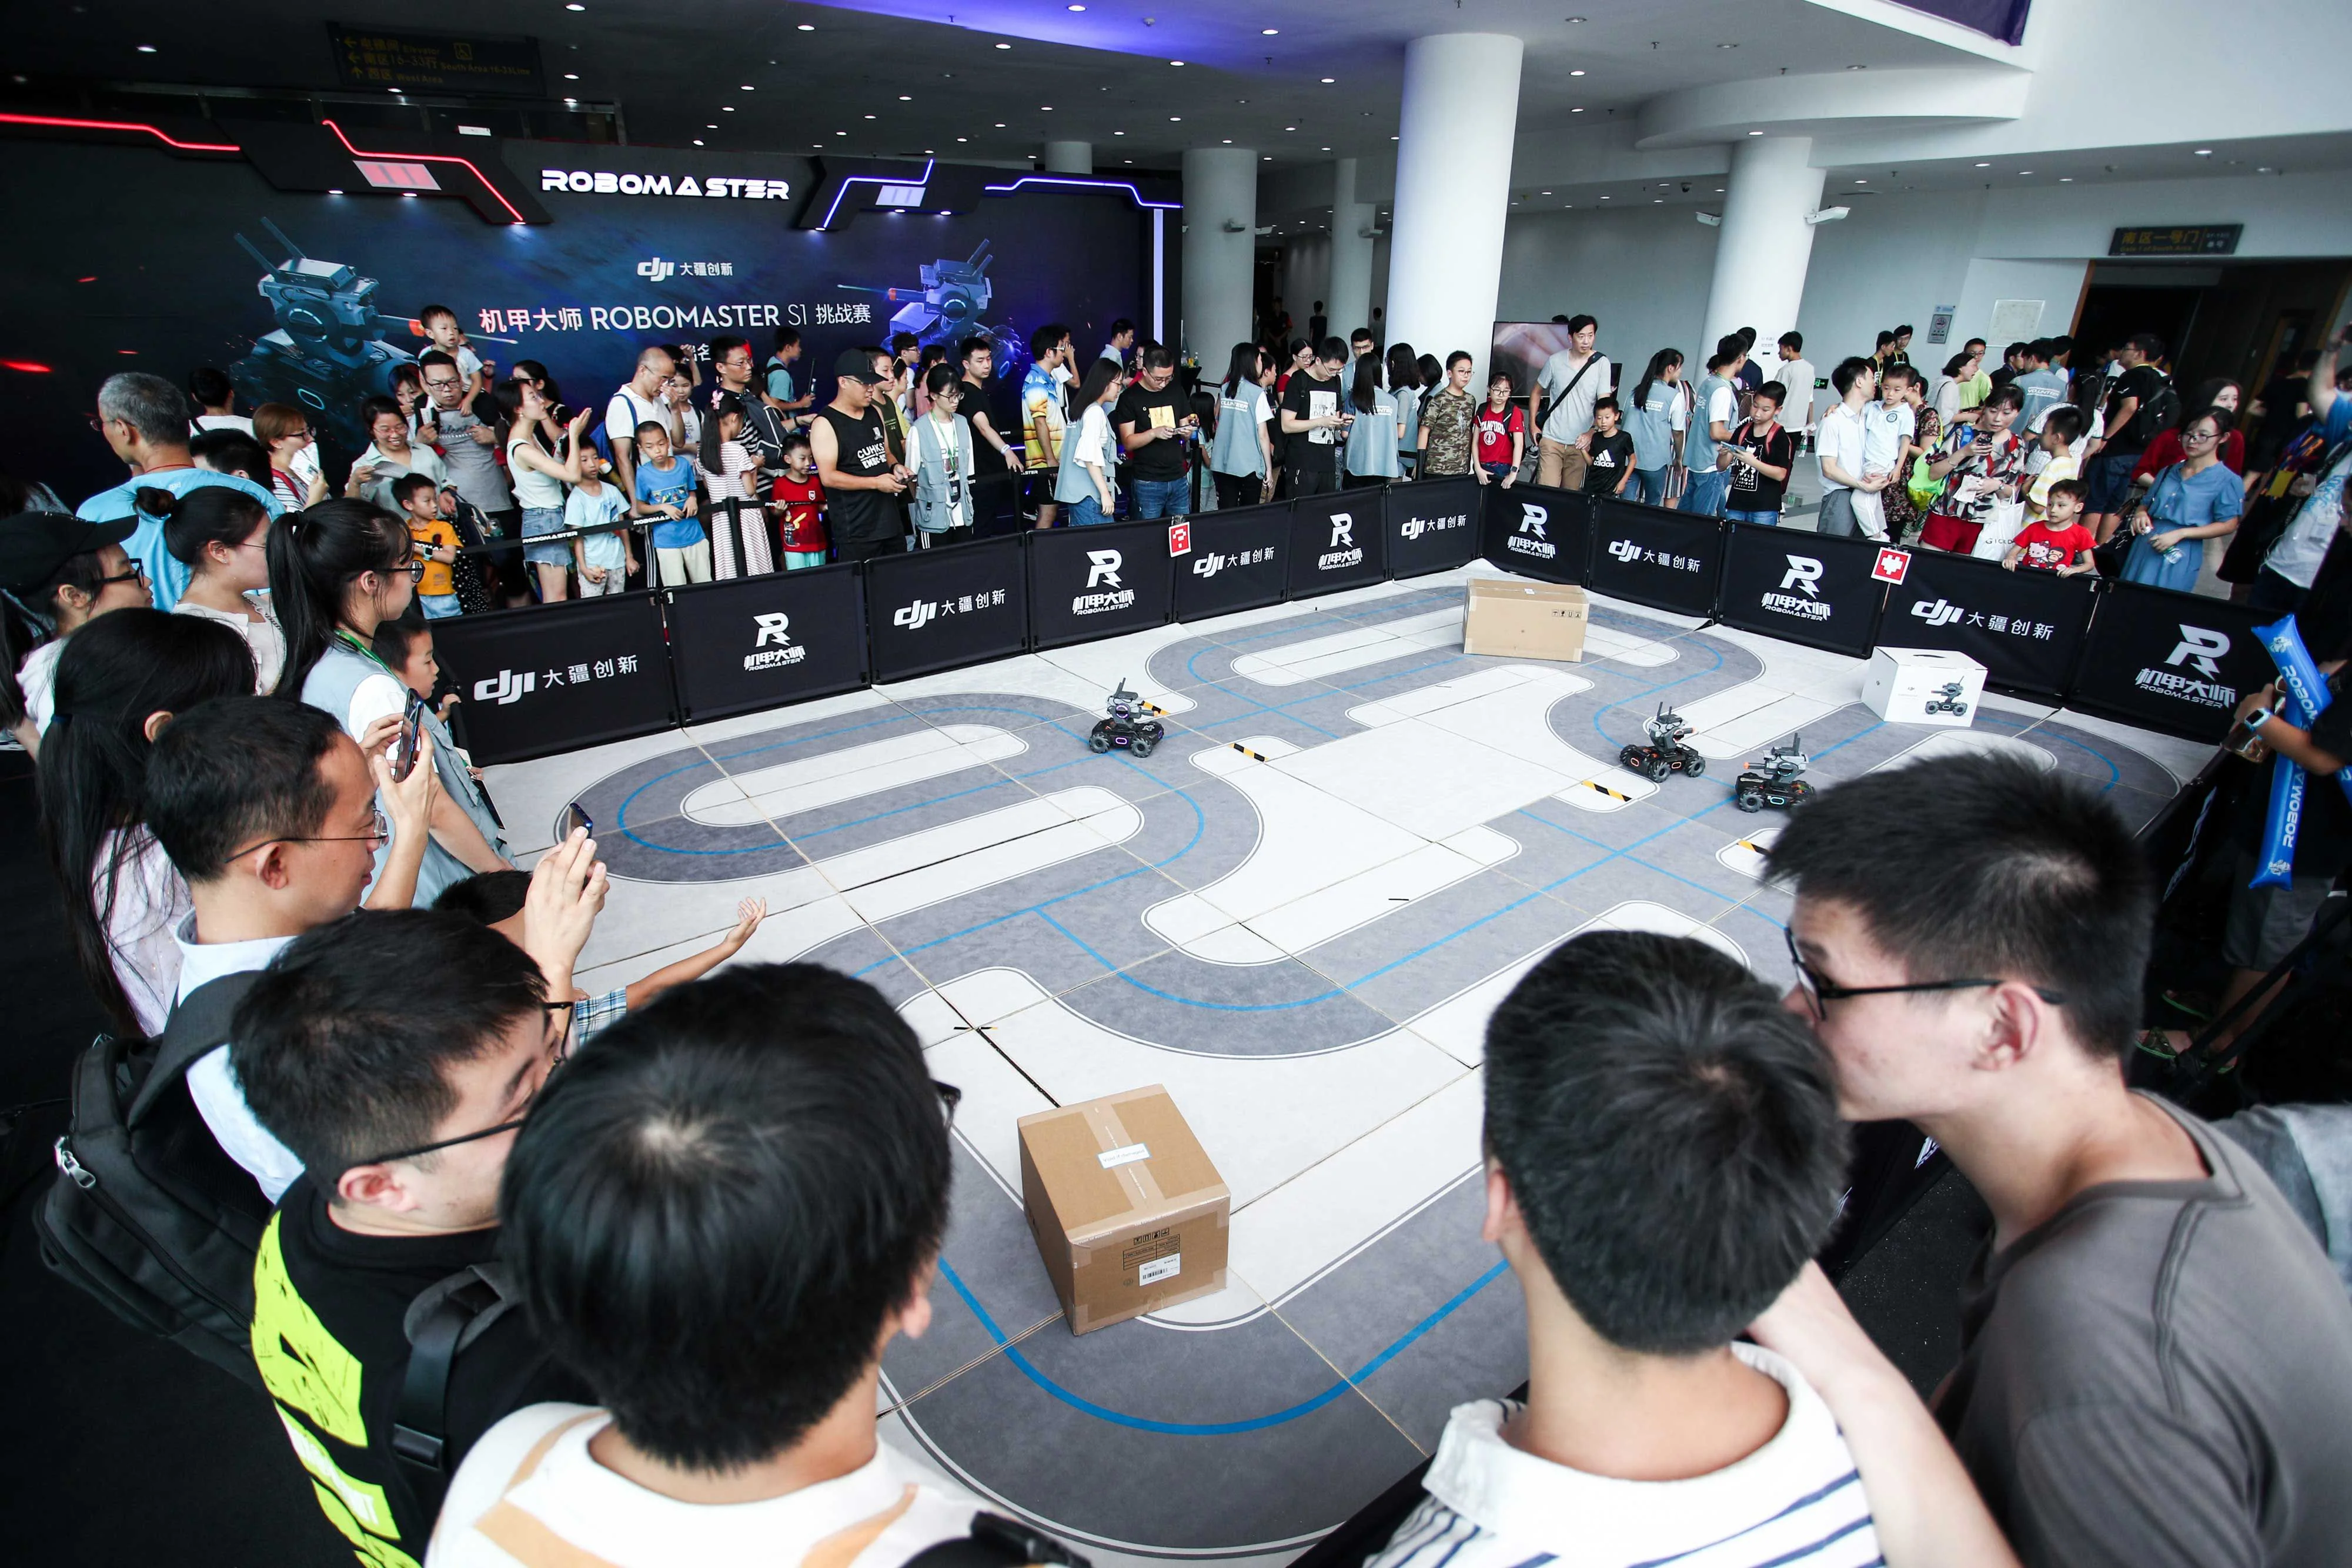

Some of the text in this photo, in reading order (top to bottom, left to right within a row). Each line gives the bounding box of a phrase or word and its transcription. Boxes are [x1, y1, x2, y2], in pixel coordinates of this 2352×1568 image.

[542, 169, 790, 200] ROBOMASTER
[680, 262, 733, 276] 大疆创新
[479, 303, 871, 334] 机甲大师 ROBOMASTER S1 挑战赛
[857, 442, 884, 459] CUHKS
[1426, 514, 1466, 532] 大疆创新
[522, 531, 578, 544] ROBOMASTER
[1508, 536, 1556, 559] 机甲大师
[1227, 546, 1275, 568] 大疆创新
[1318, 547, 1363, 570] 机甲大师
[1510, 546, 1551, 559] ROBOMASTER
[1643, 549, 1700, 573] 大疆创新
[1321, 560, 1359, 571] ROBOMASTER
[941, 589, 1005, 617] 大疆创新
[1072, 589, 1135, 614] 机甲大师
[1077, 603, 1130, 616] ROBOMASTER
[1761, 592, 1830, 621] 机甲大师
[1765, 604, 1823, 621] ROBOMASTER
[1966, 611, 2054, 640] 大疆创新
[743, 645, 806, 671] 机甲大师
[749, 657, 801, 671] ROBOMASTER
[542, 654, 637, 688] 大疆创新
[2135, 668, 2236, 708] 机甲大师
[2139, 684, 2224, 708] ROBOMASTER
